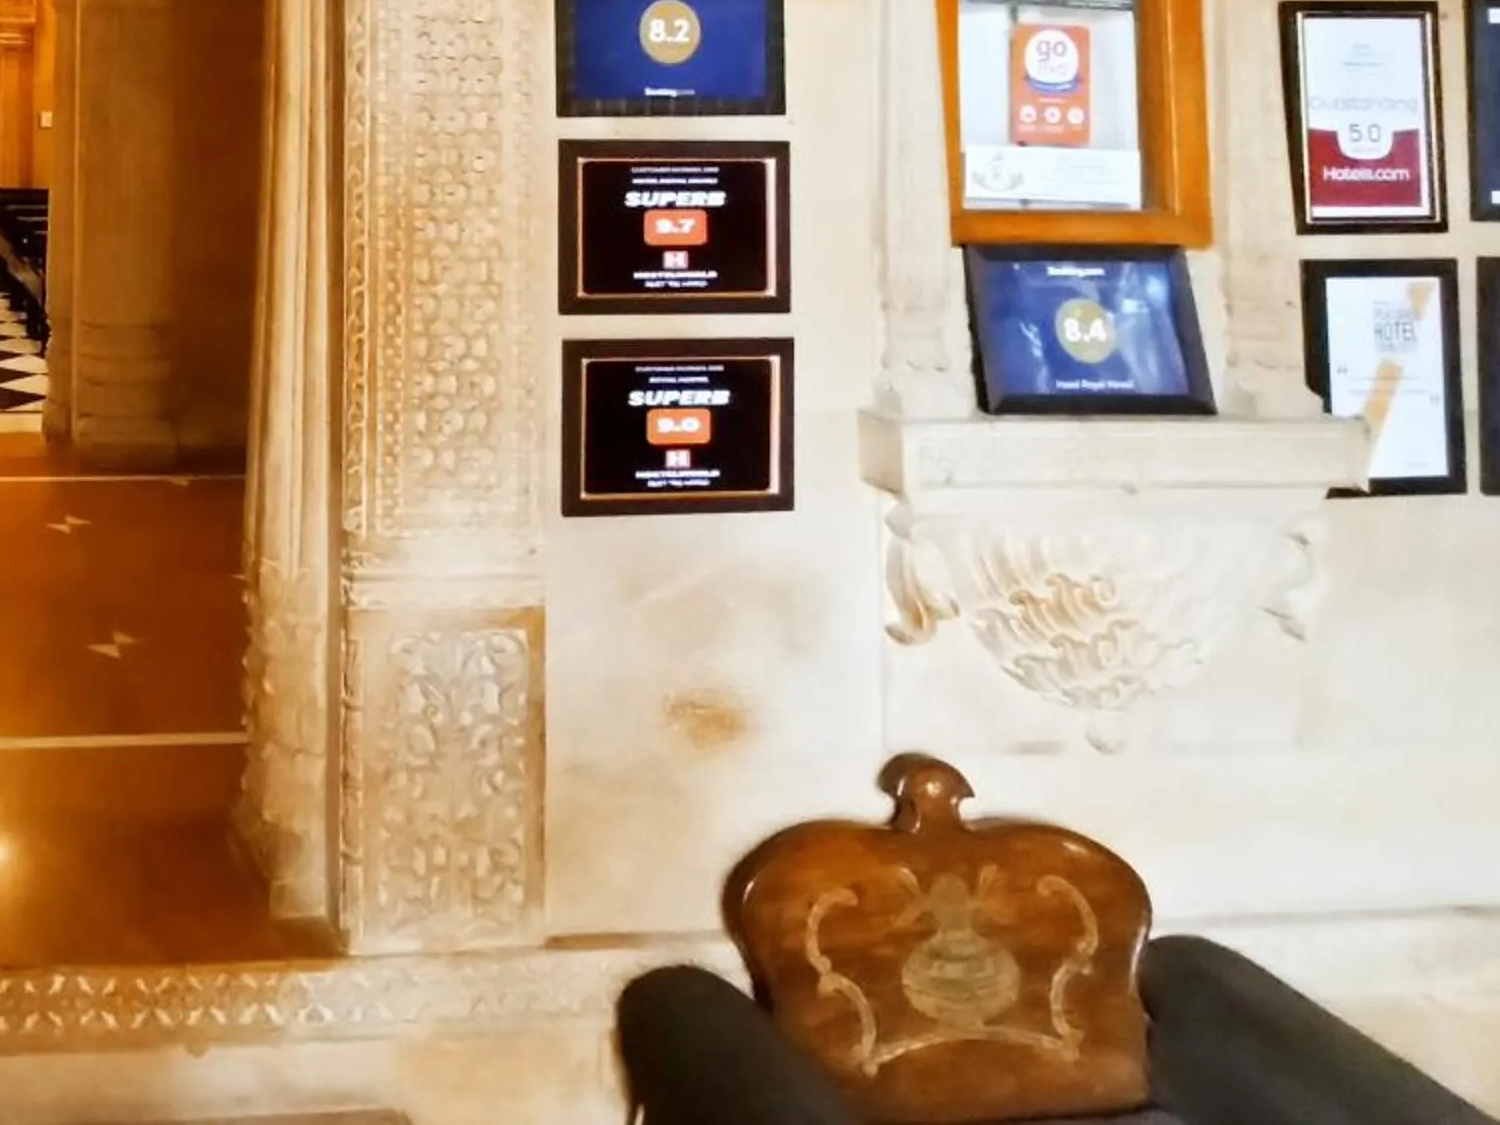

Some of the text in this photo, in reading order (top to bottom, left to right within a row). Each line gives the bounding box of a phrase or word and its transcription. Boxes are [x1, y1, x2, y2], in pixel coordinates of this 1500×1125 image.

[649, 18, 690, 43] 8.2
[1036, 39, 1067, 62] go
[624, 191, 727, 208] SUPERB
[1063, 317, 1108, 343] 8.4
[628, 389, 731, 407] SUPERB
